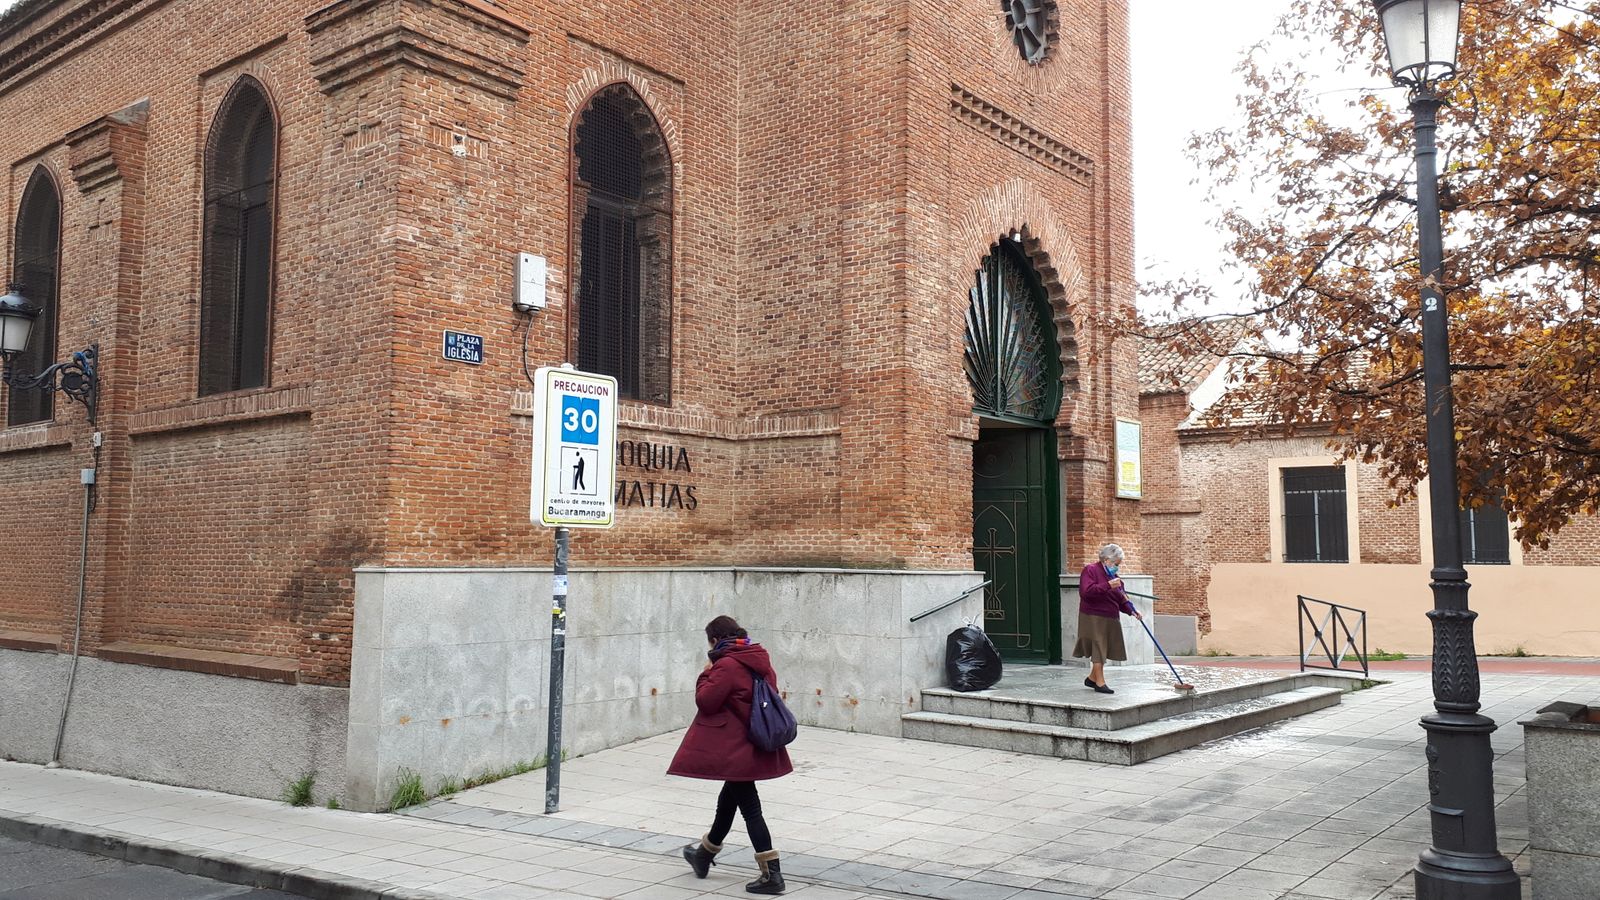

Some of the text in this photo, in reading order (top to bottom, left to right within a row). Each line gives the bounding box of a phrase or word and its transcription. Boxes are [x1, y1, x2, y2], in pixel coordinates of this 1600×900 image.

[1425, 297, 1437, 311] 2
[457, 334, 480, 345] PLAZA
[447, 346, 479, 361] IGLESIA
[554, 379, 609, 396] PRECAUCION
[563, 407, 597, 433] 30
[616, 439, 691, 472] OQUIA
[548, 506, 606, 518] Bucaramanga
